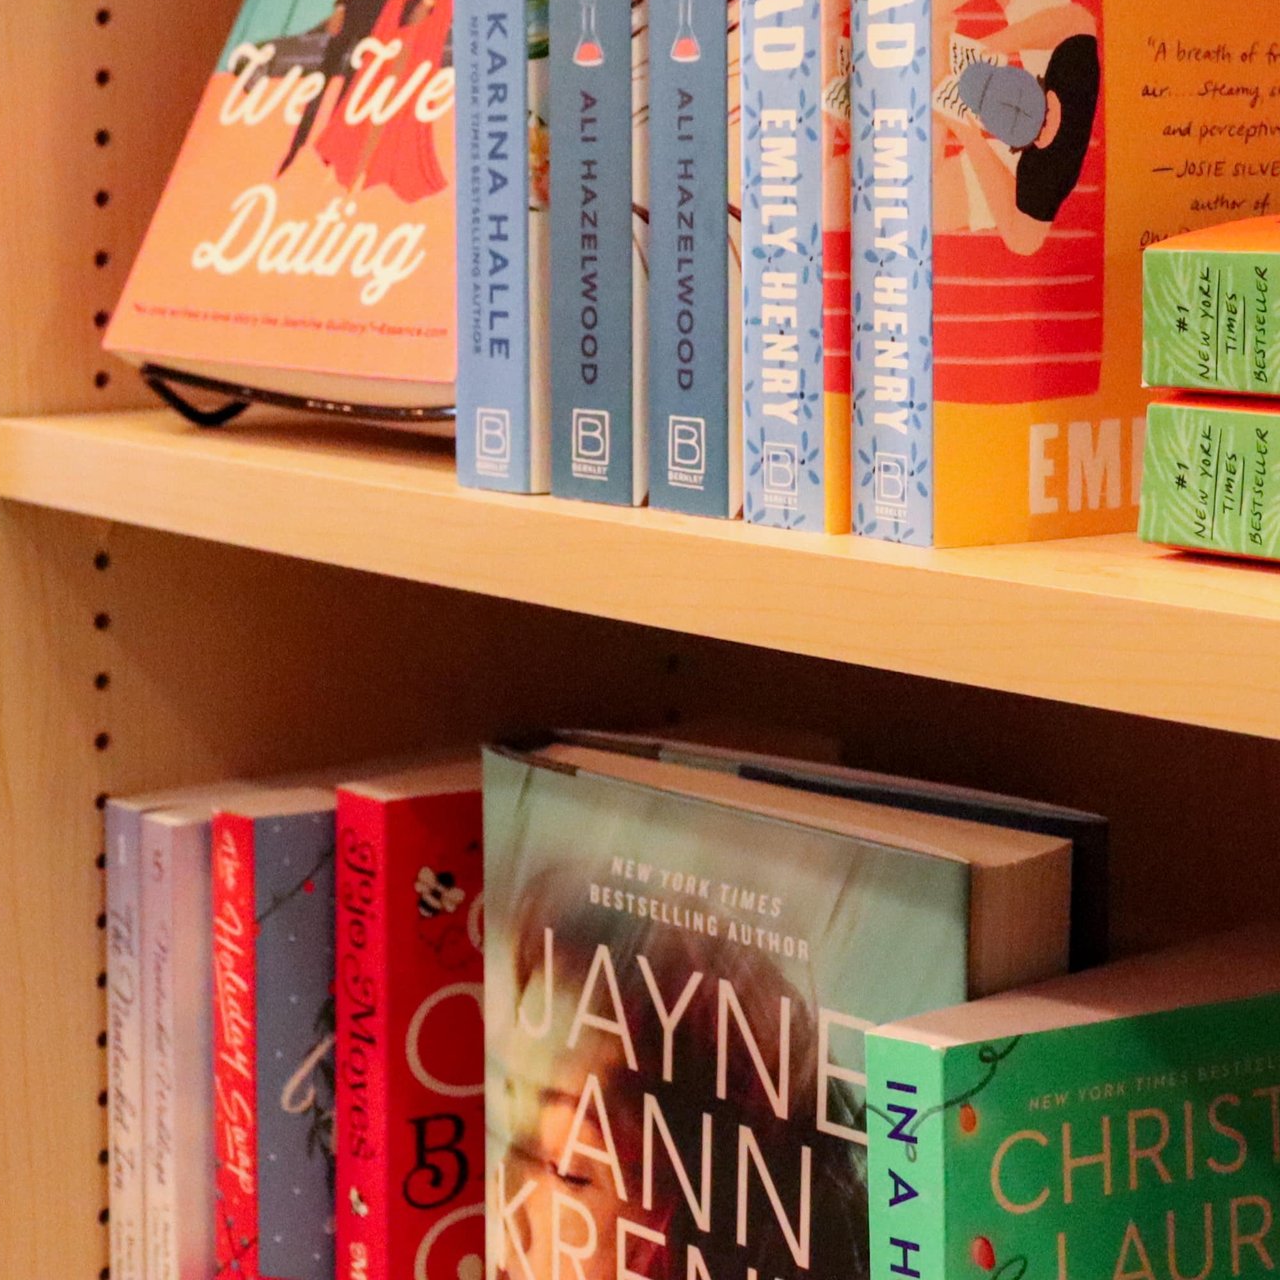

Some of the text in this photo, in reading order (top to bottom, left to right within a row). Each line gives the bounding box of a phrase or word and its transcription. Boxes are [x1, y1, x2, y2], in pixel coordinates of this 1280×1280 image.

[219, 36, 457, 128] We We
[1176, 39, 1232, 63] breath
[1240, 41, 1257, 63] of
[468, 15, 483, 355] NEW YORK TIMES BESTSELLING AUTHOR
[486, 12, 511, 361] KARINA HALLE
[759, 108, 799, 255] EMILY
[872, 108, 908, 259] EMILY
[1162, 121, 1191, 137] and
[192, 182, 427, 306] Dating
[580, 89, 599, 386] ALI HAZELWOOD
[676, 88, 695, 391] ALI HAZELWOOD
[1190, 192, 1270, 214] author of
[761, 272, 799, 426] HENRY
[873, 272, 908, 436] HENRY
[1176, 303, 1190, 333] #1
[1198, 266, 1214, 380] NEW YORK
[1224, 291, 1238, 354] TIMES
[1253, 266, 1270, 383] BESTSELLER
[1175, 460, 1189, 491] #1
[1192, 424, 1213, 540] NEW YORK
[1222, 453, 1237, 514] TIMES
[1248, 427, 1270, 547] BESTSELLER
[589, 883, 810, 961] BESTSELLING AUTHOR
[611, 856, 782, 918] NEW YORK TIMES
[214, 900, 252, 1080] Holiday
[341, 828, 378, 1162] Jojo Moyes
[517, 926, 869, 1146] JAYNE
[214, 1075, 255, 1195] Swap
[885, 1080, 920, 1208] IN A
[1028, 1092, 1067, 1112] NEW
[1077, 1085, 1126, 1103] YORK
[1135, 1072, 1189, 1093] TIMES
[557, 1072, 812, 1270] ANN
